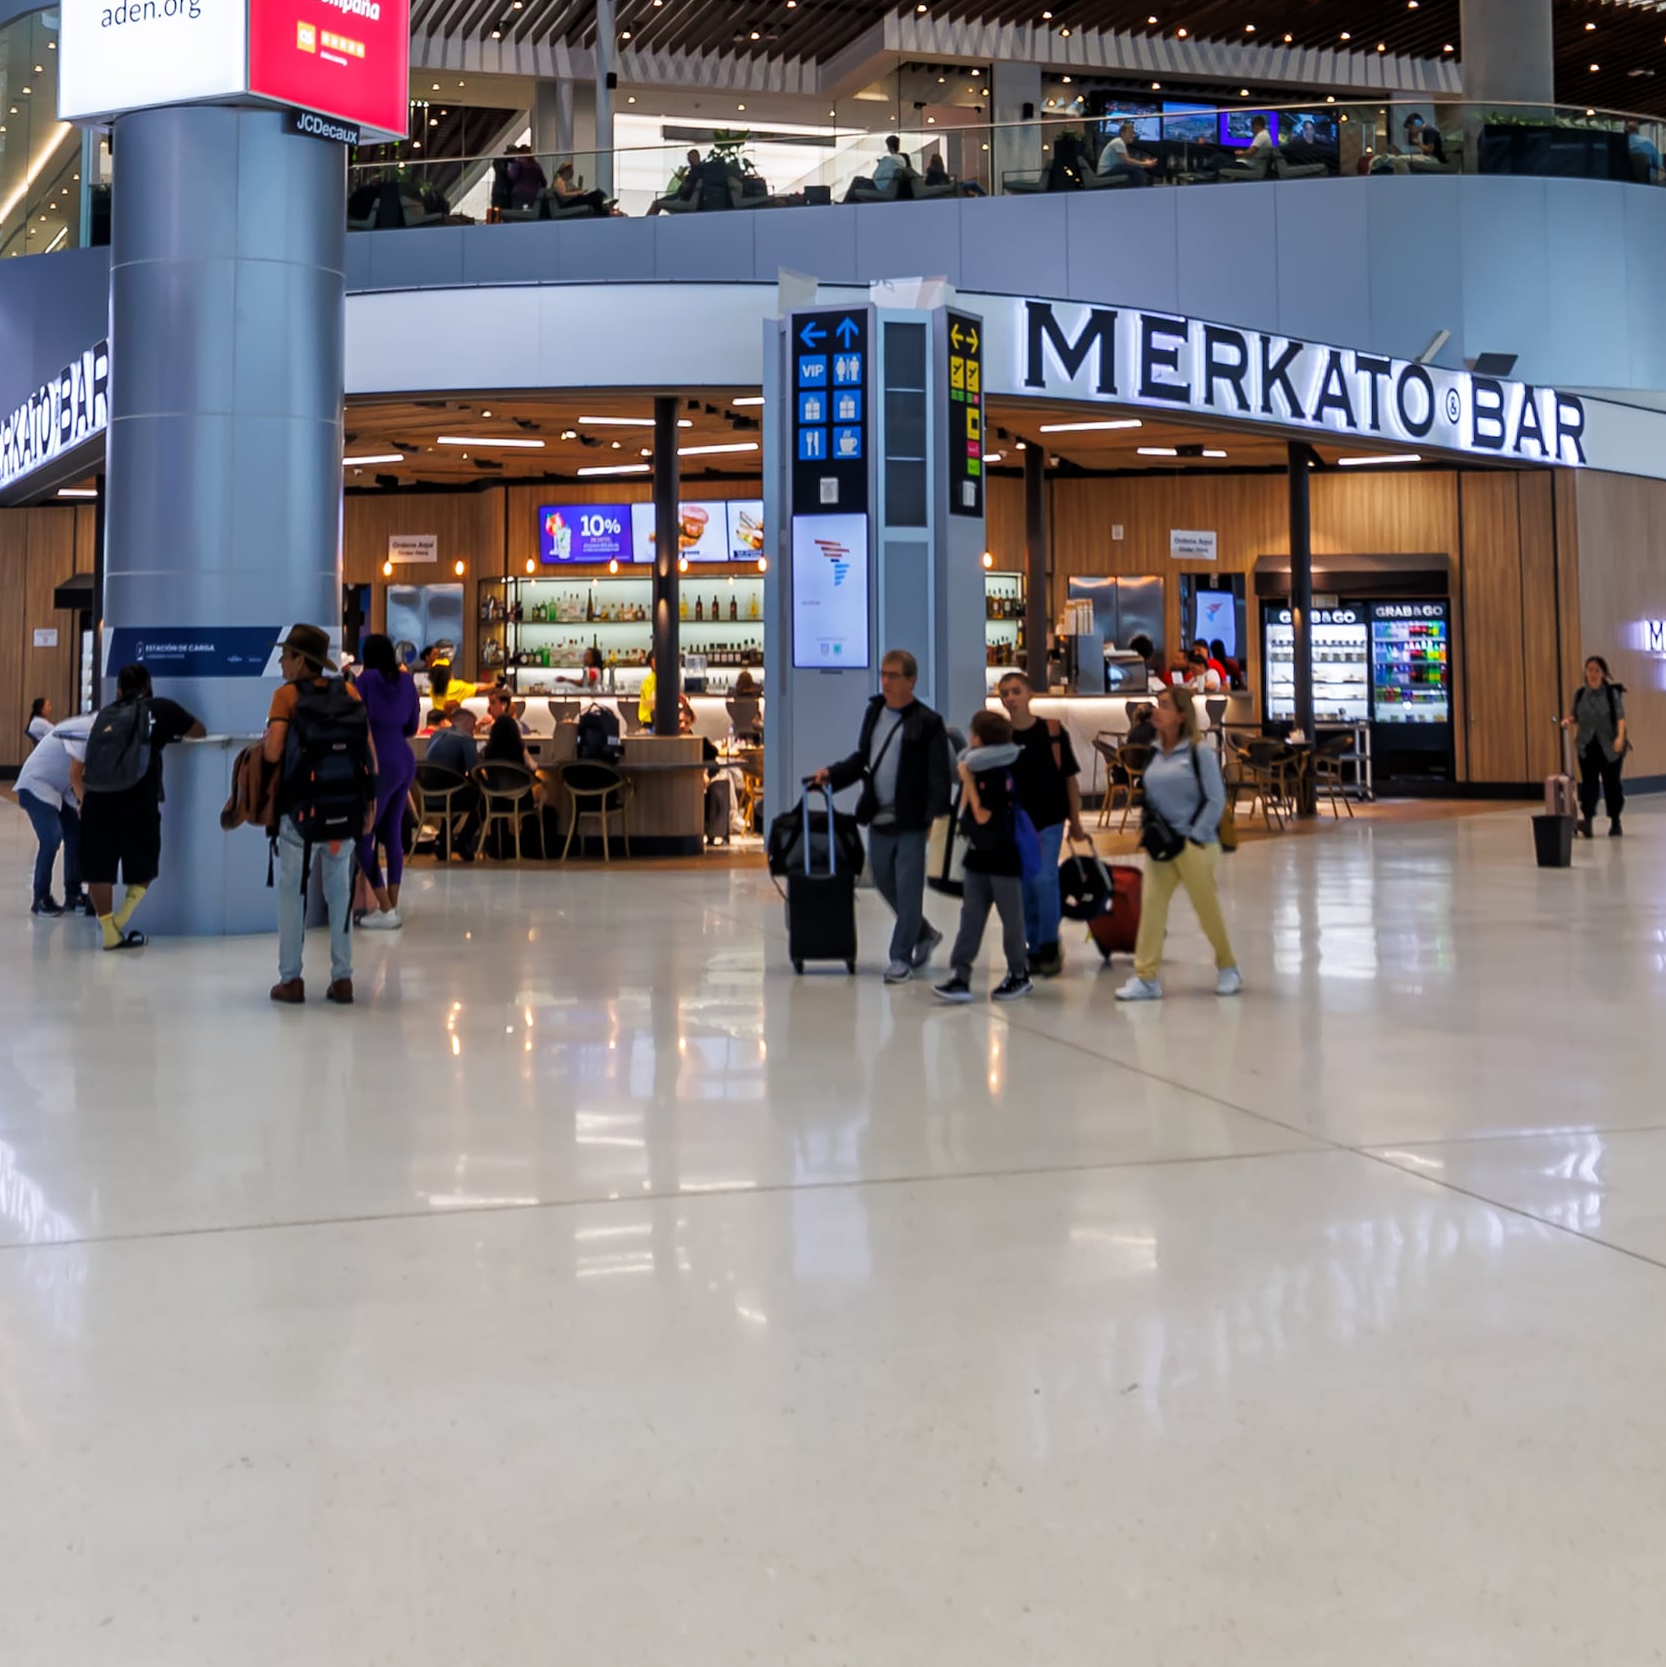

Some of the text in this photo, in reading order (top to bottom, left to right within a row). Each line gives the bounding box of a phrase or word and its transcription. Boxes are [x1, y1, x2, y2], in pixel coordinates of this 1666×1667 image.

[296, 113, 357, 145] JCDecaux
[801, 363, 825, 379] VIP
[1023, 300, 1435, 438] MERKATO
[1471, 374, 1588, 465] BAR
[580, 514, 621, 537] 10%
